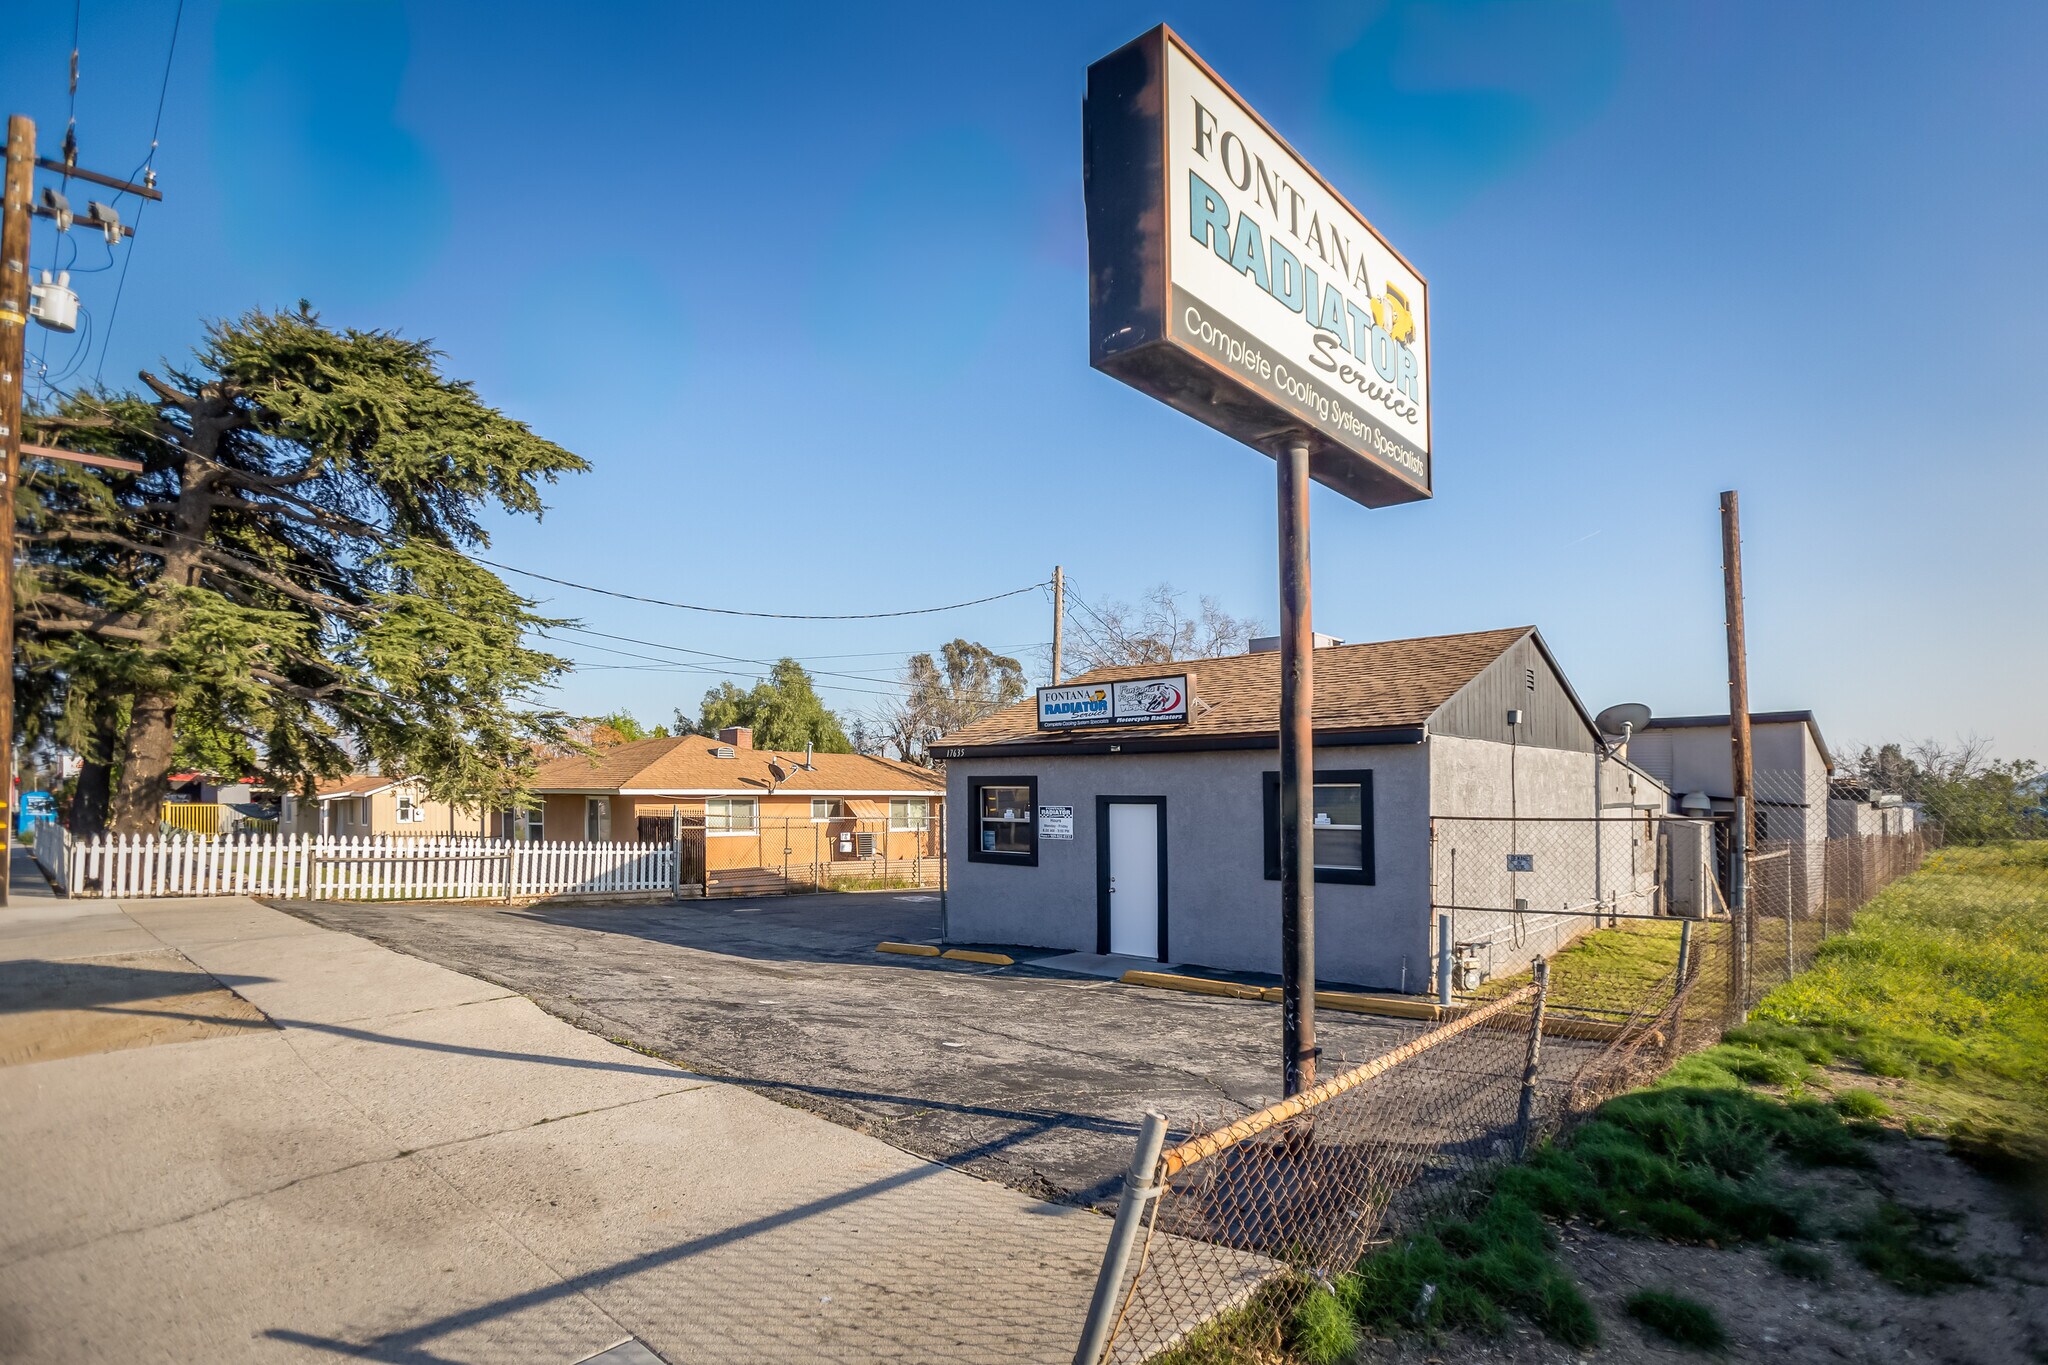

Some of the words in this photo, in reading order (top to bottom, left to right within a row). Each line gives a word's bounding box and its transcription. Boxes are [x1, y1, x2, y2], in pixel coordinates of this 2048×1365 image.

[1191, 95, 1373, 299] FONTANA
[1189, 168, 1420, 406] RADIATOR
[1308, 333, 1419, 425] Service
[1185, 306, 1271, 380] Complete
[1274, 364, 1330, 421] Cooling
[1331, 399, 1373, 443] System
[1373, 427, 1424, 477] Specialists
[1045, 690, 1091, 702] FONTANA
[1044, 700, 1108, 715] RADIATOR
[1071, 709, 1108, 719] Service
[1116, 715, 1150, 723] Motorcycle
[946, 748, 965, 758] 17635
